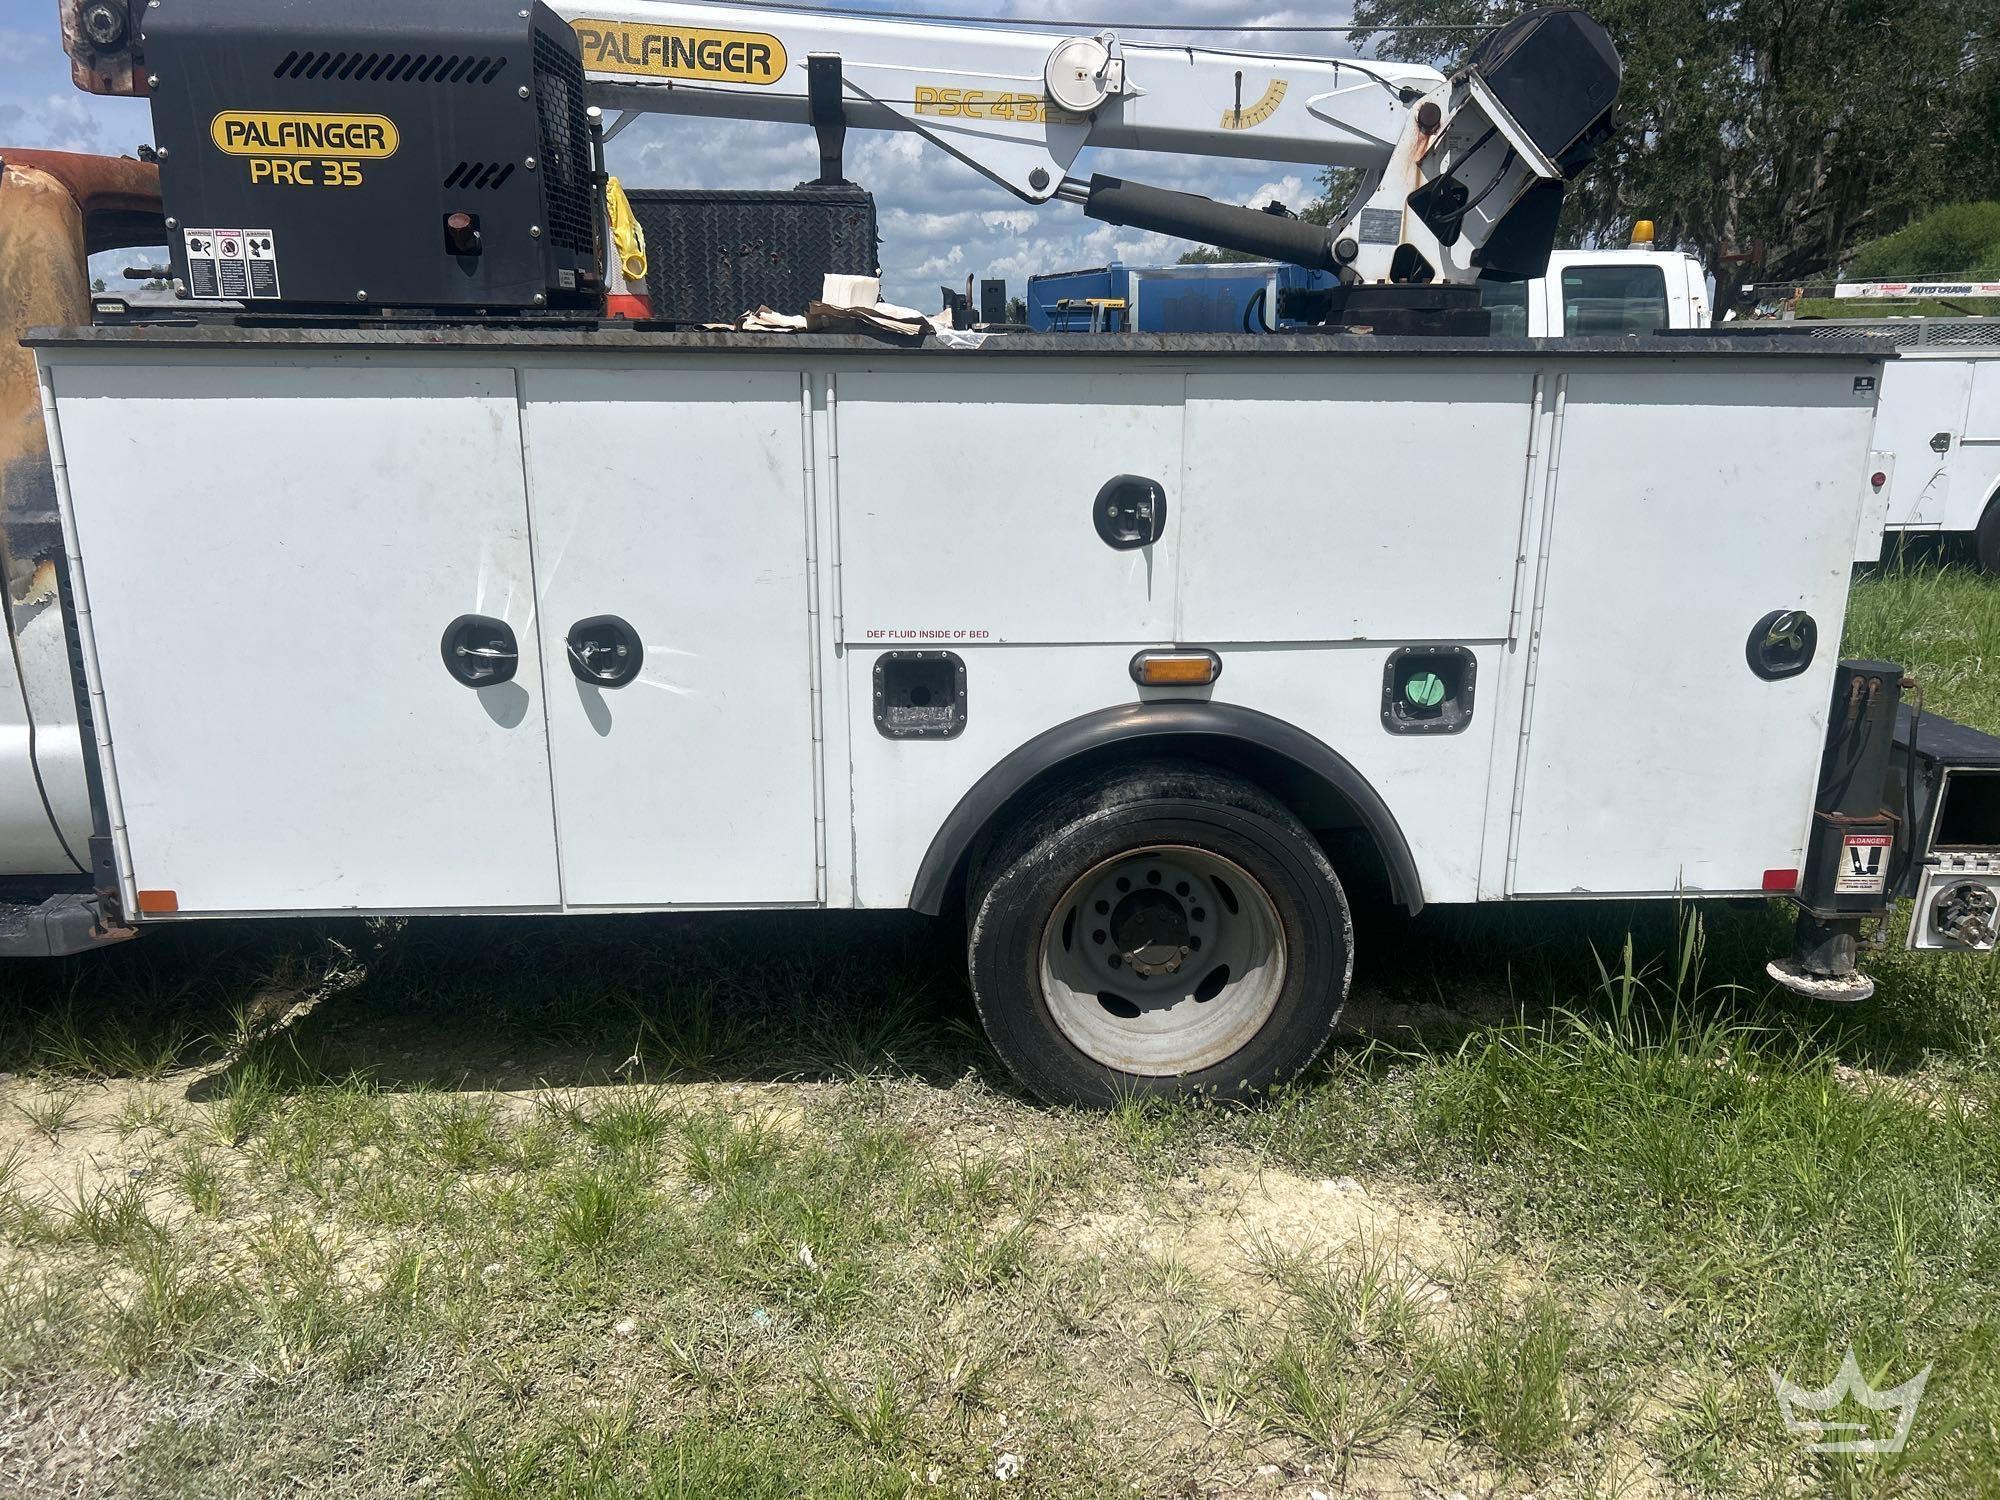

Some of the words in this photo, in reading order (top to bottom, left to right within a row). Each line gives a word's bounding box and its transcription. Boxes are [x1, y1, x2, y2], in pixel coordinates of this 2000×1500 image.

[576, 29, 771, 75] PALFINGER
[914, 86, 984, 118] PSC
[224, 120, 386, 149] PALFINGER
[250, 159, 314, 184] PRC
[321, 160, 363, 186] 35
[866, 630, 886, 639] DEF
[888, 630, 917, 639] FLUID
[919, 630, 951, 639] INSIDE
[953, 630, 967, 639] OF
[969, 630, 990, 639] BED
